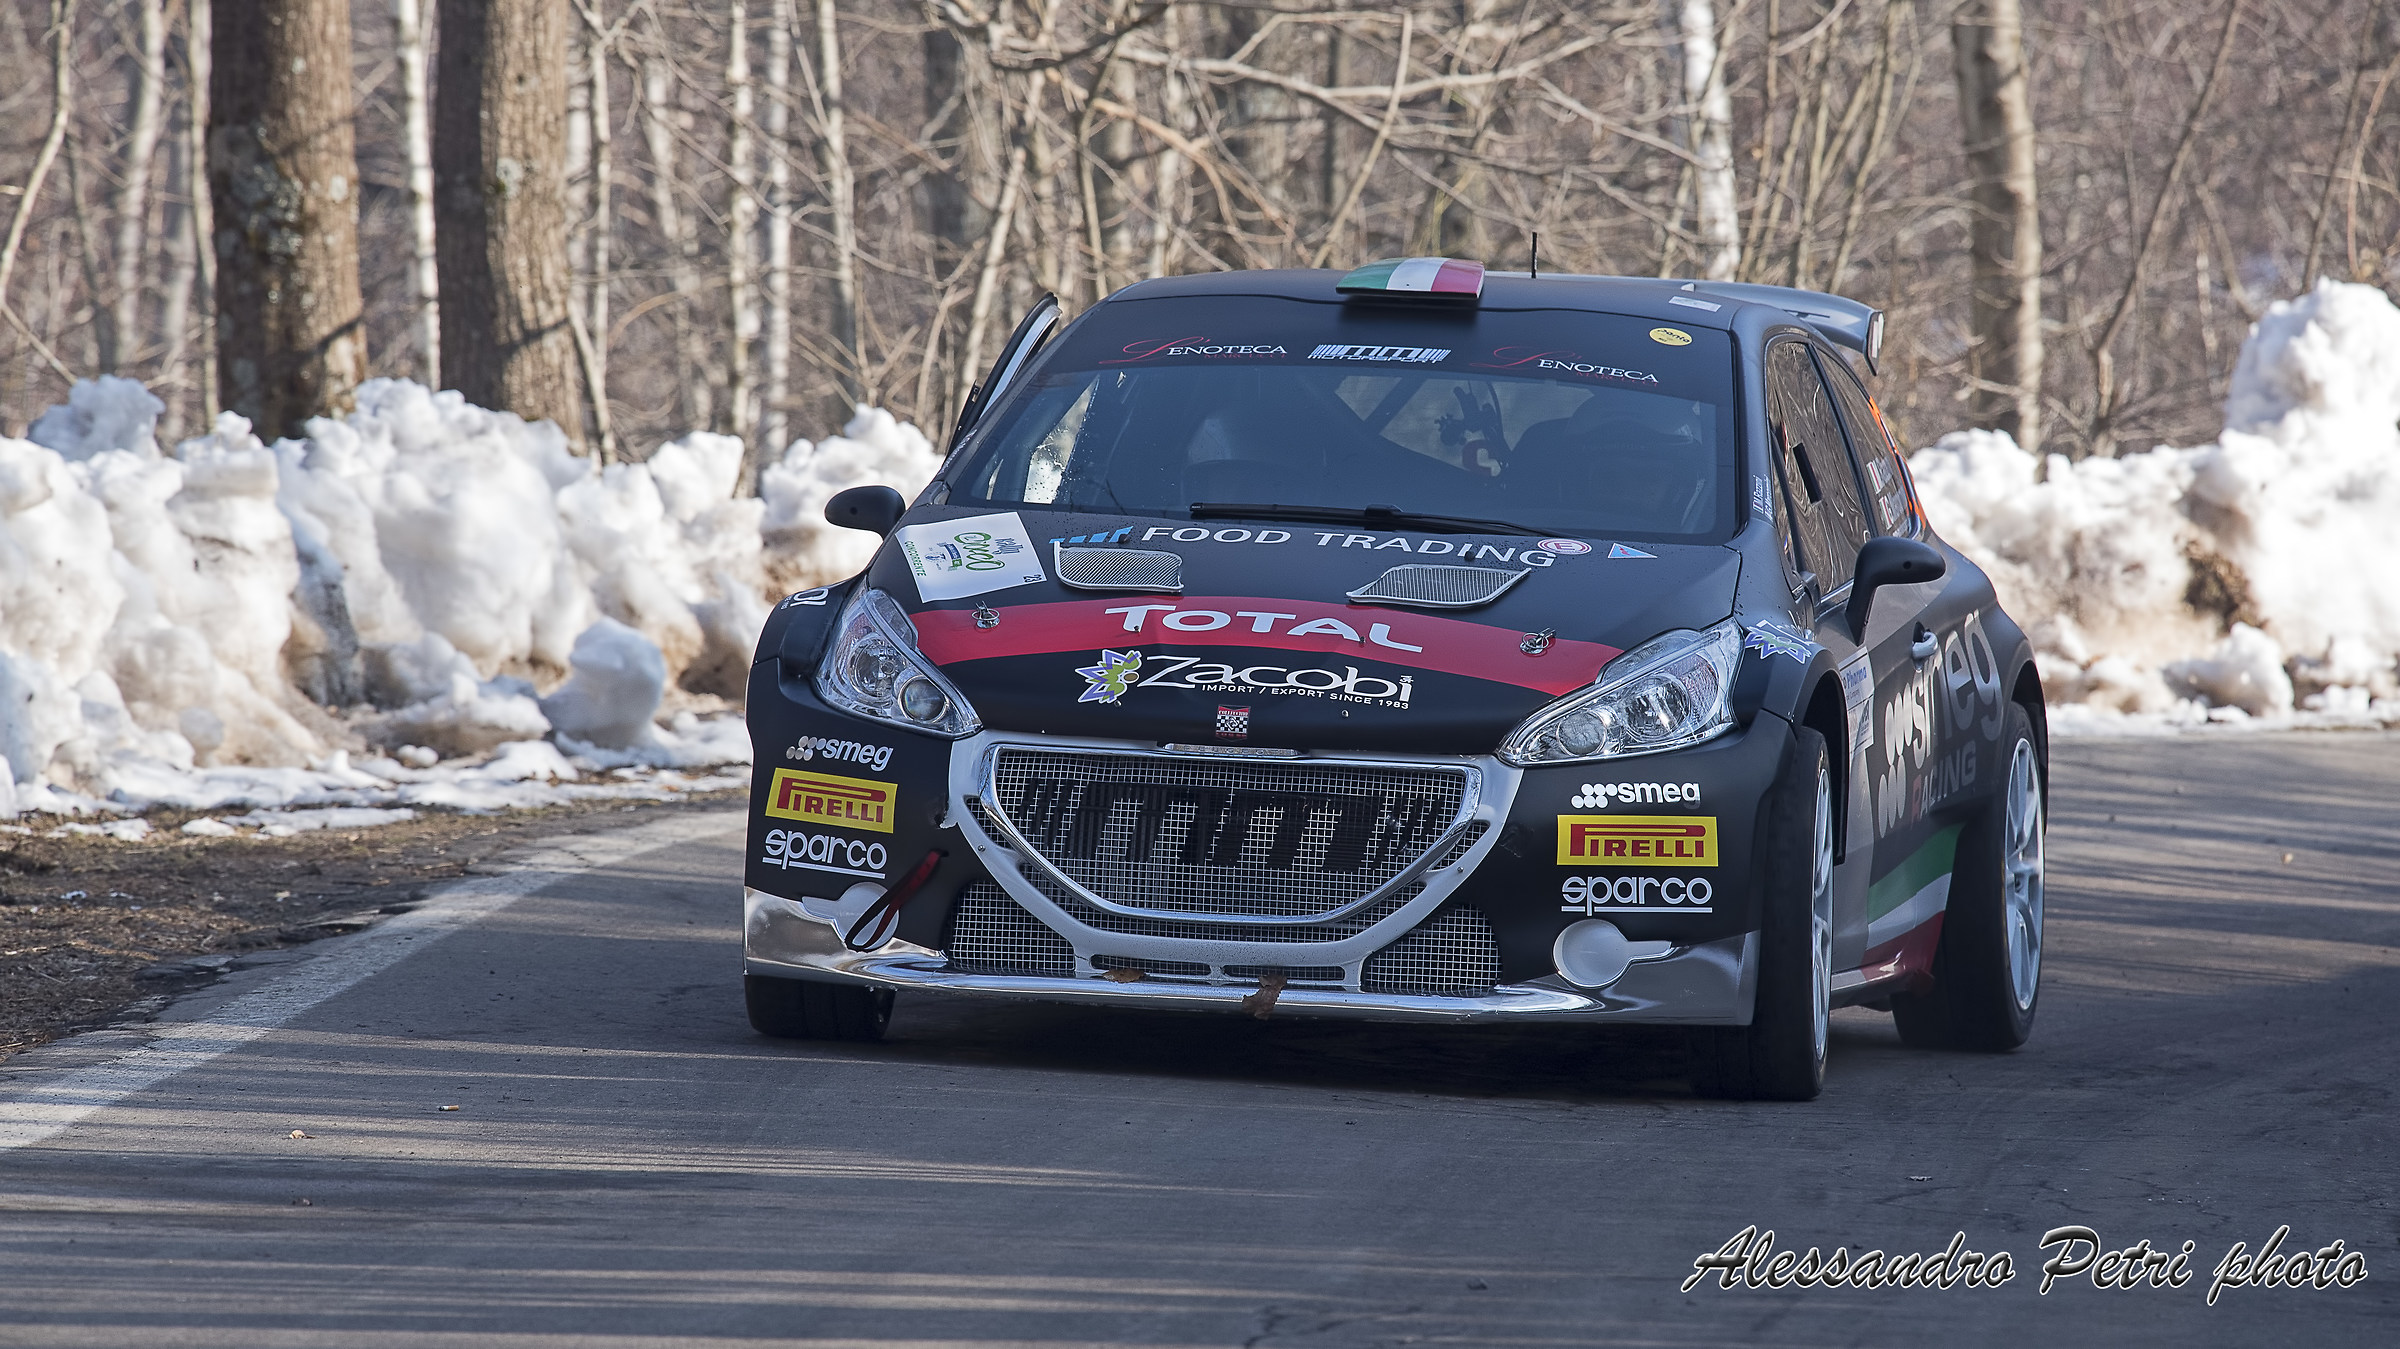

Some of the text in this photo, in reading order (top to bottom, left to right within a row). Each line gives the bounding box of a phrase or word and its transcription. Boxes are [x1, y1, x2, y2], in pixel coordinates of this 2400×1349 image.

[904, 540, 927, 577] CONCORRENTE
[1141, 527, 1558, 567] FOOD TRADING
[1023, 574, 1042, 583] 23
[1105, 604, 1423, 653] TOTAL
[1136, 655, 1414, 703] Zacobi
[1202, 684, 1255, 694] IMPORT
[1271, 688, 1325, 698] EXPORT
[1329, 693, 1372, 705] SINCE
[1378, 699, 1410, 710] 1983
[821, 738, 894, 772] smeg
[776, 776, 887, 824] PIRELLI
[1617, 781, 1701, 810] smeg
[764, 828, 888, 871] sparco
[1569, 823, 1707, 858] PIRELLI
[1561, 876, 1713, 917] sparco
